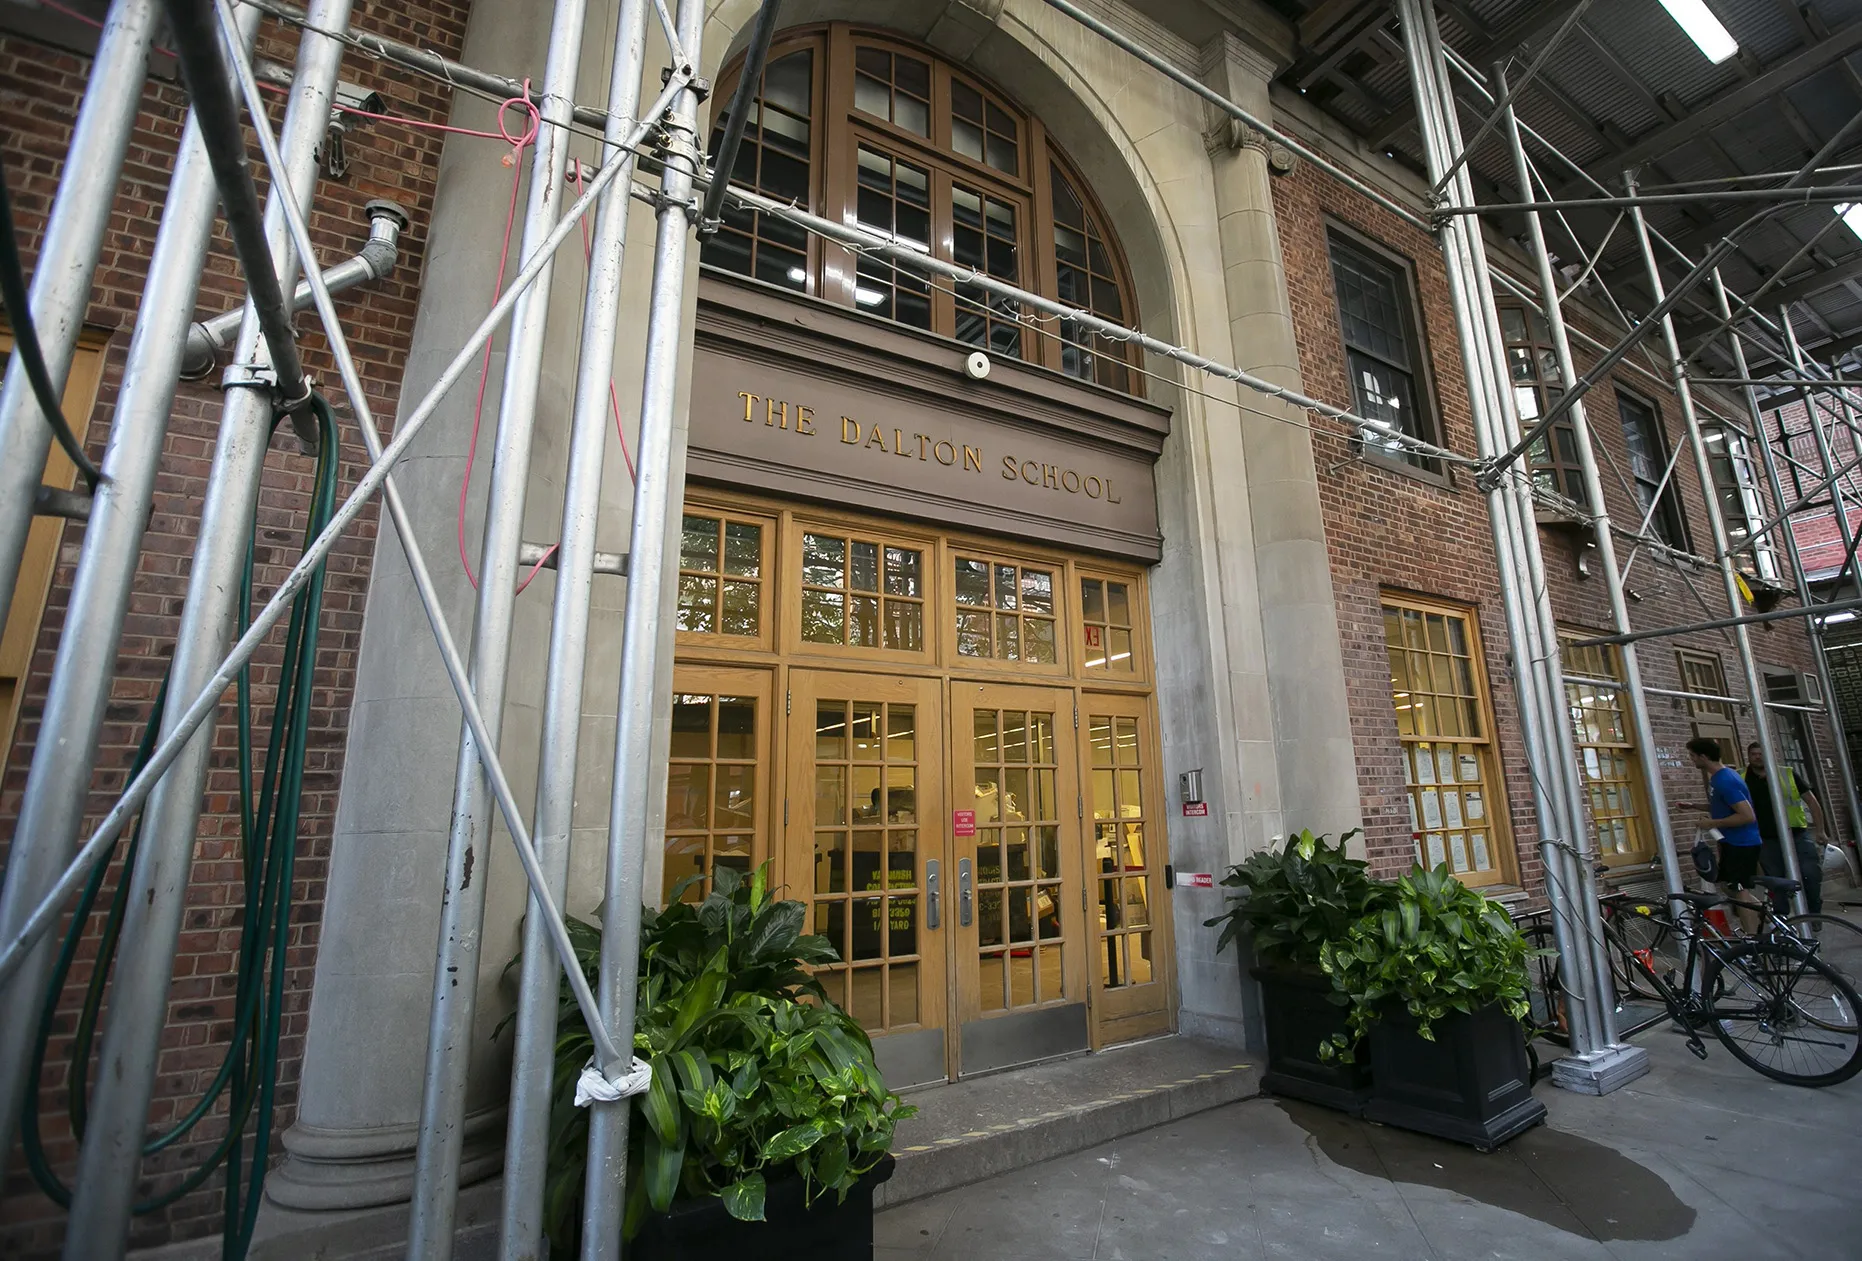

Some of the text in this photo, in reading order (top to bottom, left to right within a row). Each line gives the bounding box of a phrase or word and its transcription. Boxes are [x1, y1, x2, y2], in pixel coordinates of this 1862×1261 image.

[737, 391, 1122, 504] THE DALTON SCHOOL
